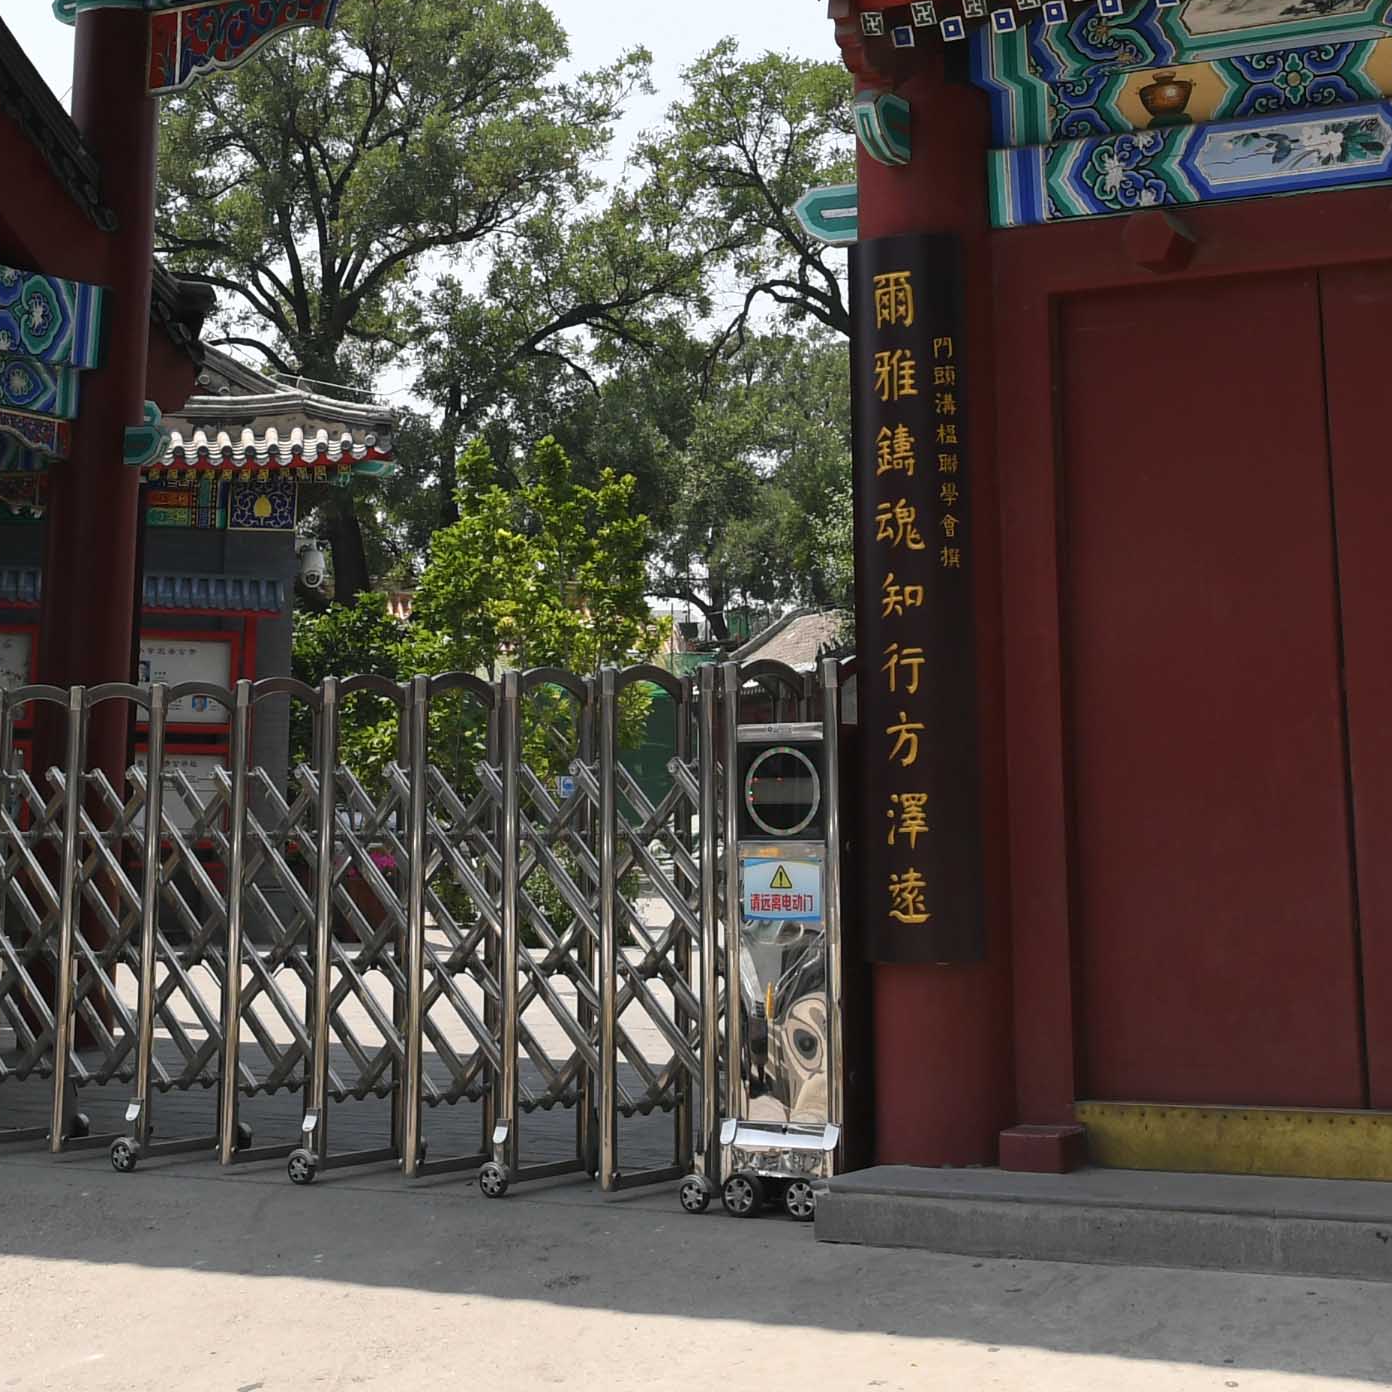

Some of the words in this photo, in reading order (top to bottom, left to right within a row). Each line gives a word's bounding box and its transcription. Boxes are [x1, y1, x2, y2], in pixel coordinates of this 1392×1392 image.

[873, 271, 930, 924] 爾雅鑄魂知行方澤遠
[751, 893, 814, 912] 请远离电动门
